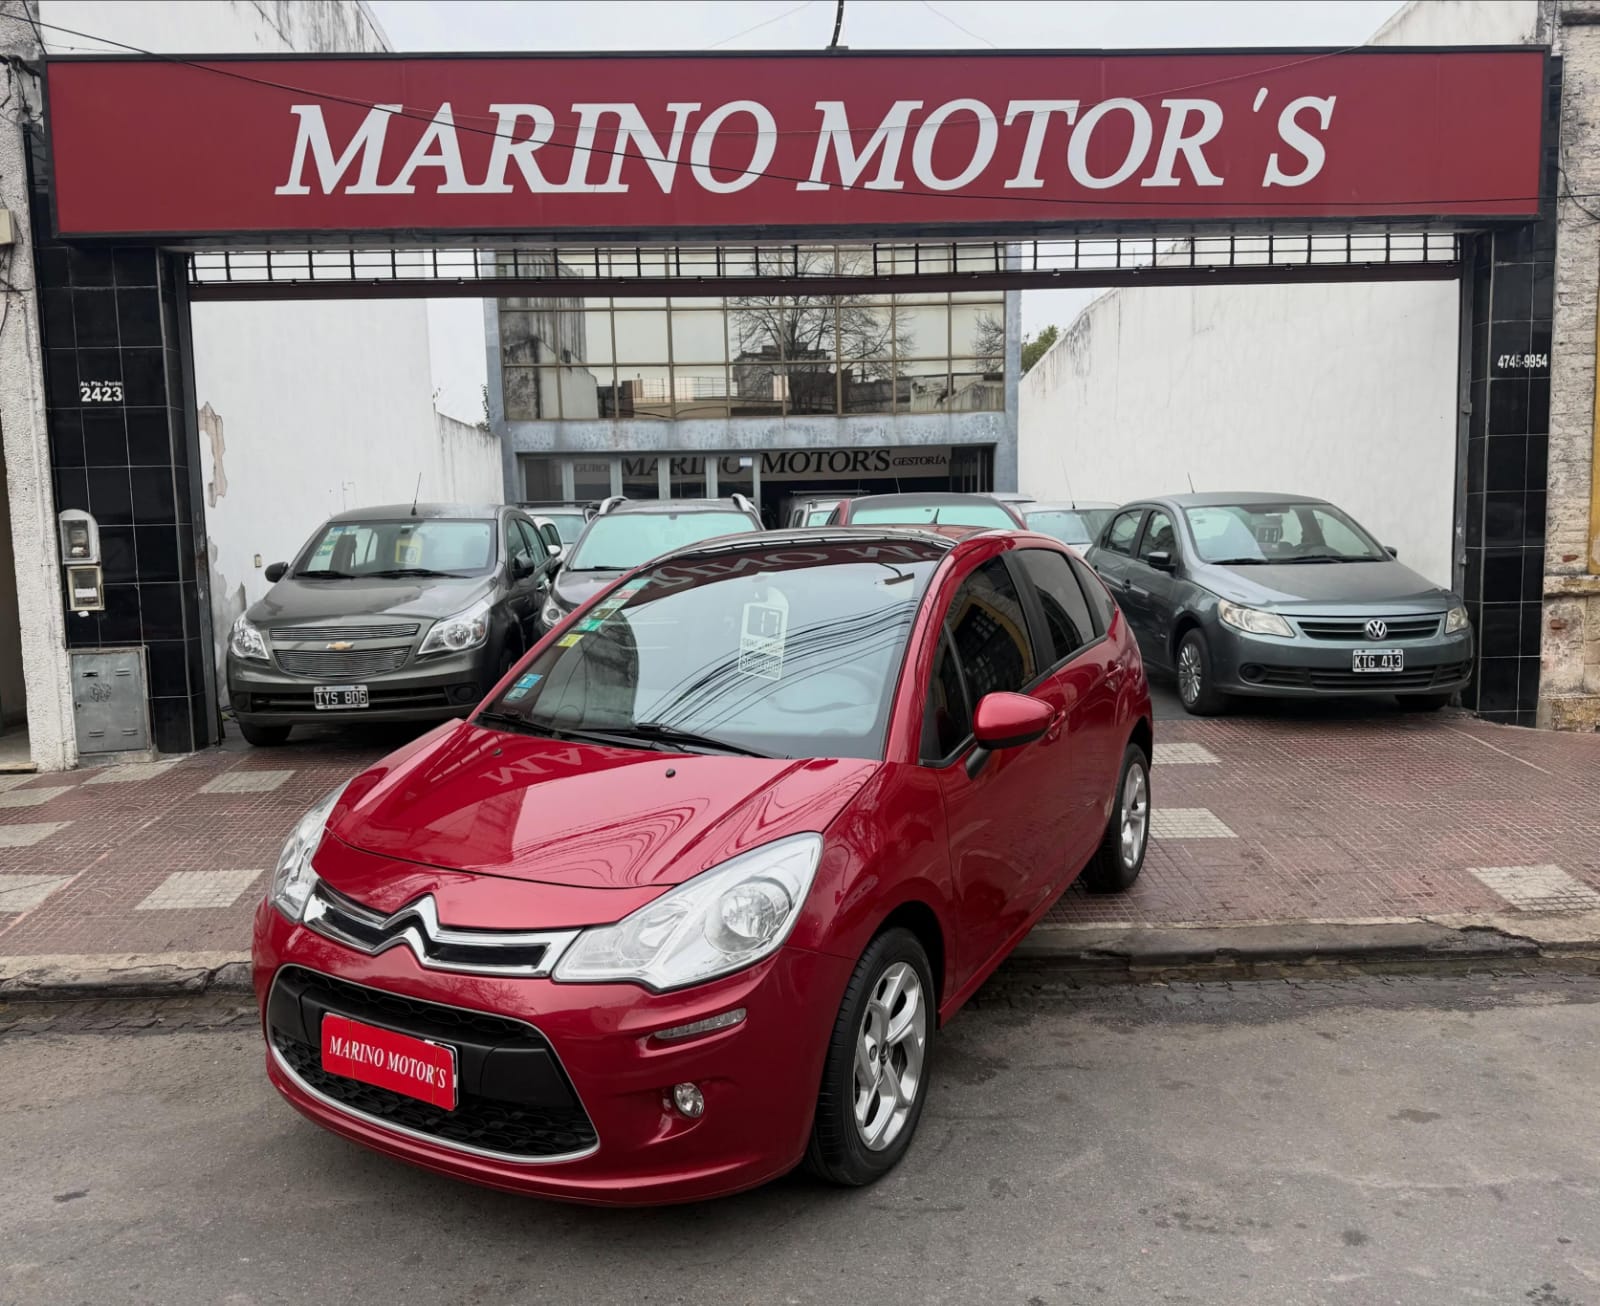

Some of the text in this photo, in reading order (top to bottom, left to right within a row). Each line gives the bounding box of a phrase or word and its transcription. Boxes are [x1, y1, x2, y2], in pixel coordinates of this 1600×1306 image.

[274, 99, 778, 195] MARINO
[1497, 353, 1548, 369] 4745-9954
[80, 386, 123, 402] 2423
[760, 449, 891, 474] MOTOR'S
[892, 453, 947, 467] GESTORÍA
[1381, 655, 1402, 667] 413
[344, 691, 367, 704] 806
[328, 1035, 447, 1089] MARINO MOTOR'S
